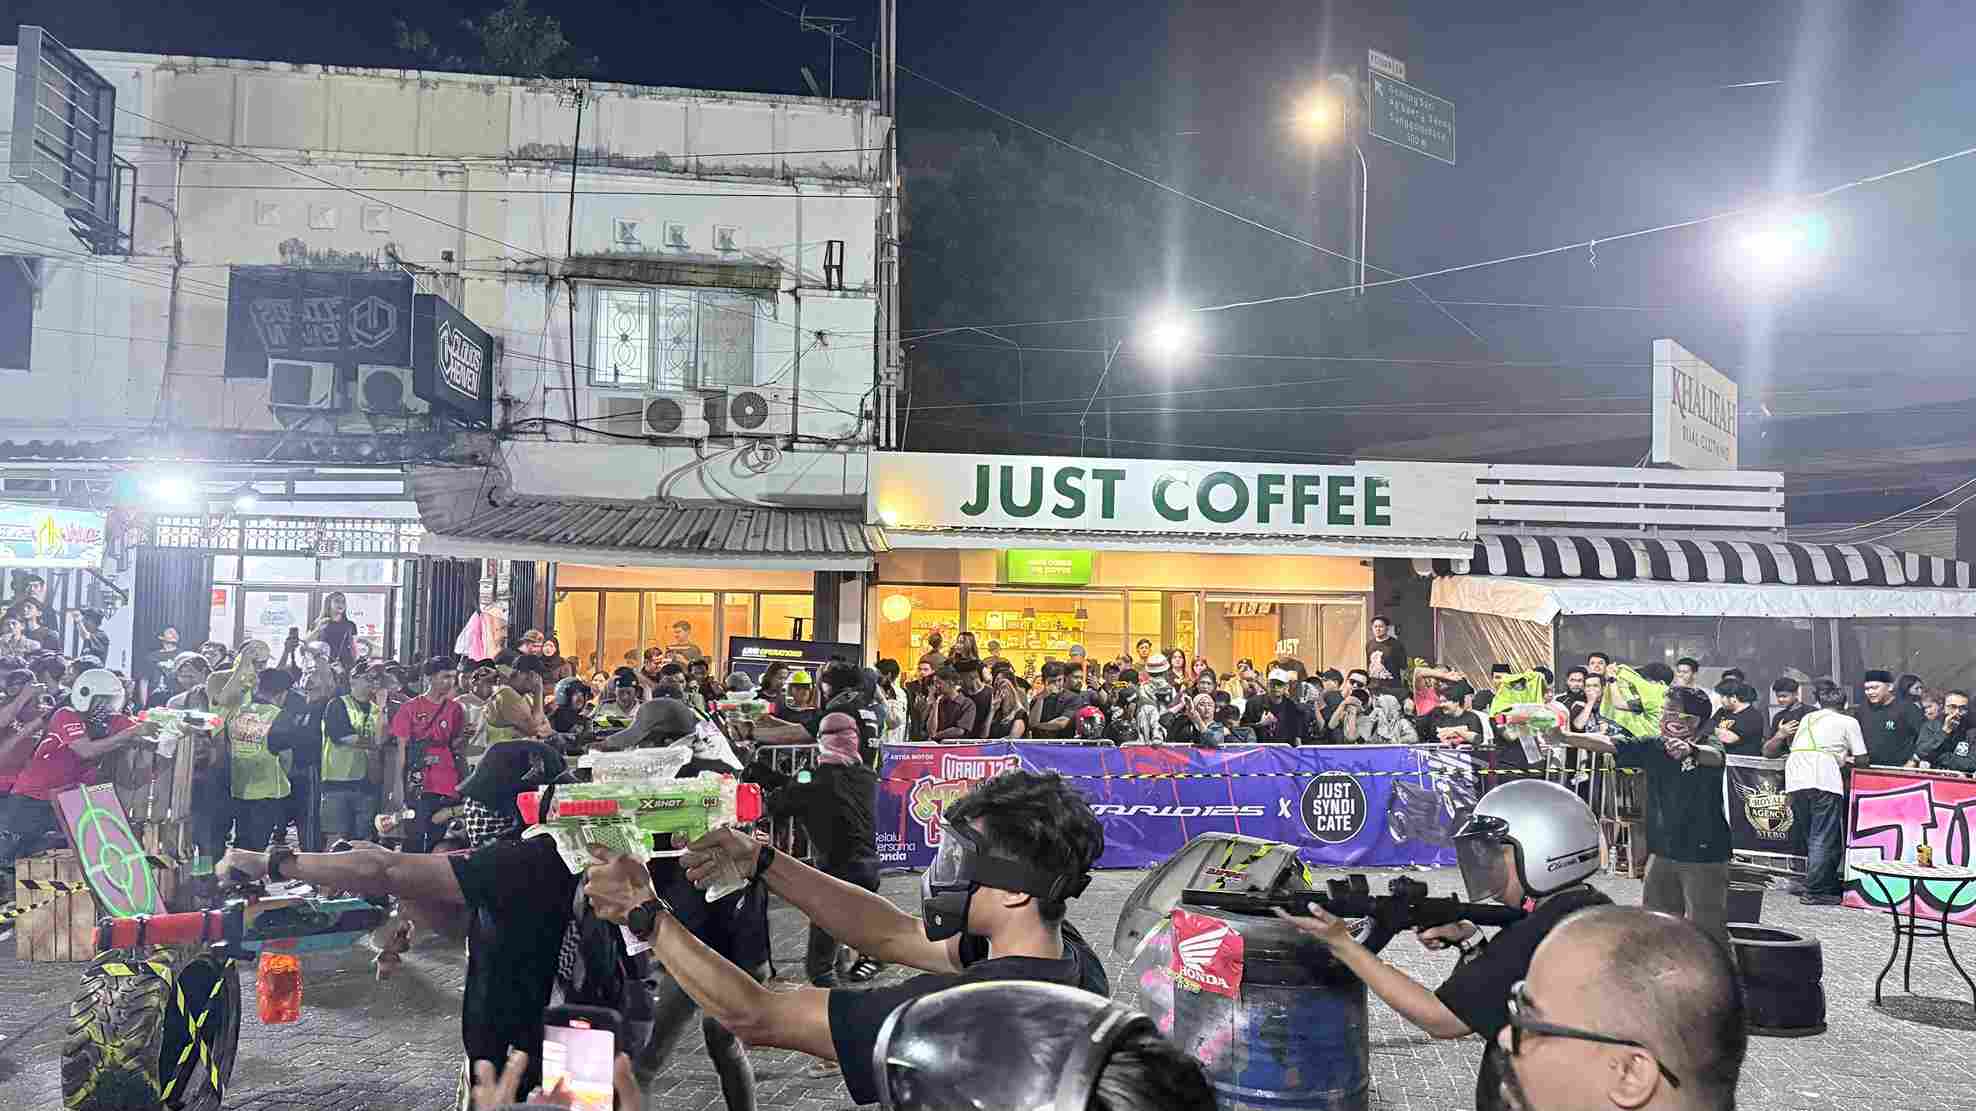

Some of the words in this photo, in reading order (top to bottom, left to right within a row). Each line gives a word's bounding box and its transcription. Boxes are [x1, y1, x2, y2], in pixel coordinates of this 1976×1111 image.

[452, 333, 481, 371] CLOUDS
[449, 357, 479, 394] HEAVEN
[1671, 365, 1737, 438] KHALIFAH
[959, 463, 1127, 520] JUST
[1151, 470, 1392, 527] COFFEE
[890, 753, 910, 761] ASTRA
[945, 760, 986, 778] VARIO
[1317, 783, 1351, 799] JUST
[1313, 799, 1355, 816] SYNDI
[1317, 815, 1352, 832] CATE
[876, 841, 916, 852] ersama
[879, 850, 907, 862] onda
[1183, 964, 1229, 989] HONDA
